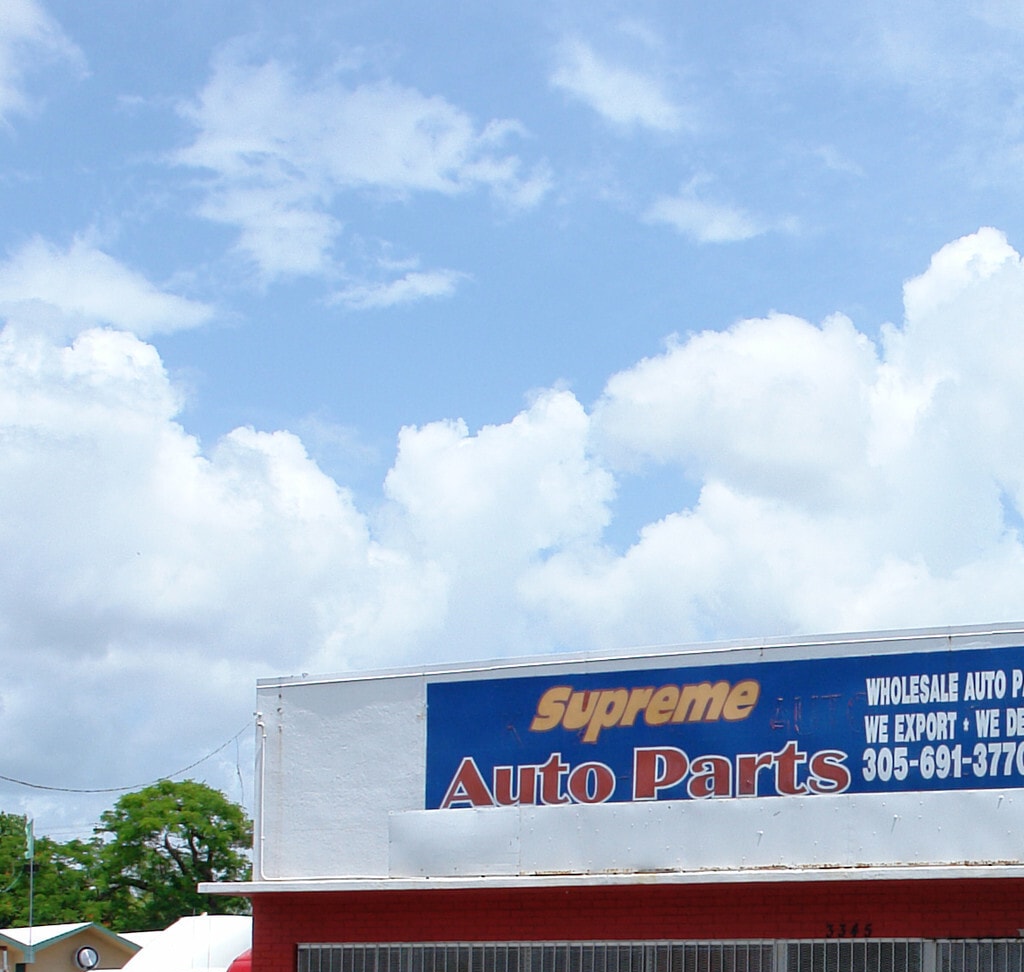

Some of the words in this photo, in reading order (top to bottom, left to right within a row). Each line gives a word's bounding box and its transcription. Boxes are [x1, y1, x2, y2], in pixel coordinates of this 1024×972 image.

[530, 679, 760, 744] Supreme
[866, 672, 959, 705] WHOLESALE
[963, 670, 1007, 701] AUTO
[864, 714, 889, 744] WE
[894, 711, 958, 743] EXPORT
[975, 708, 1000, 738] WE
[440, 752, 616, 810] Auto
[633, 741, 852, 801] Parts
